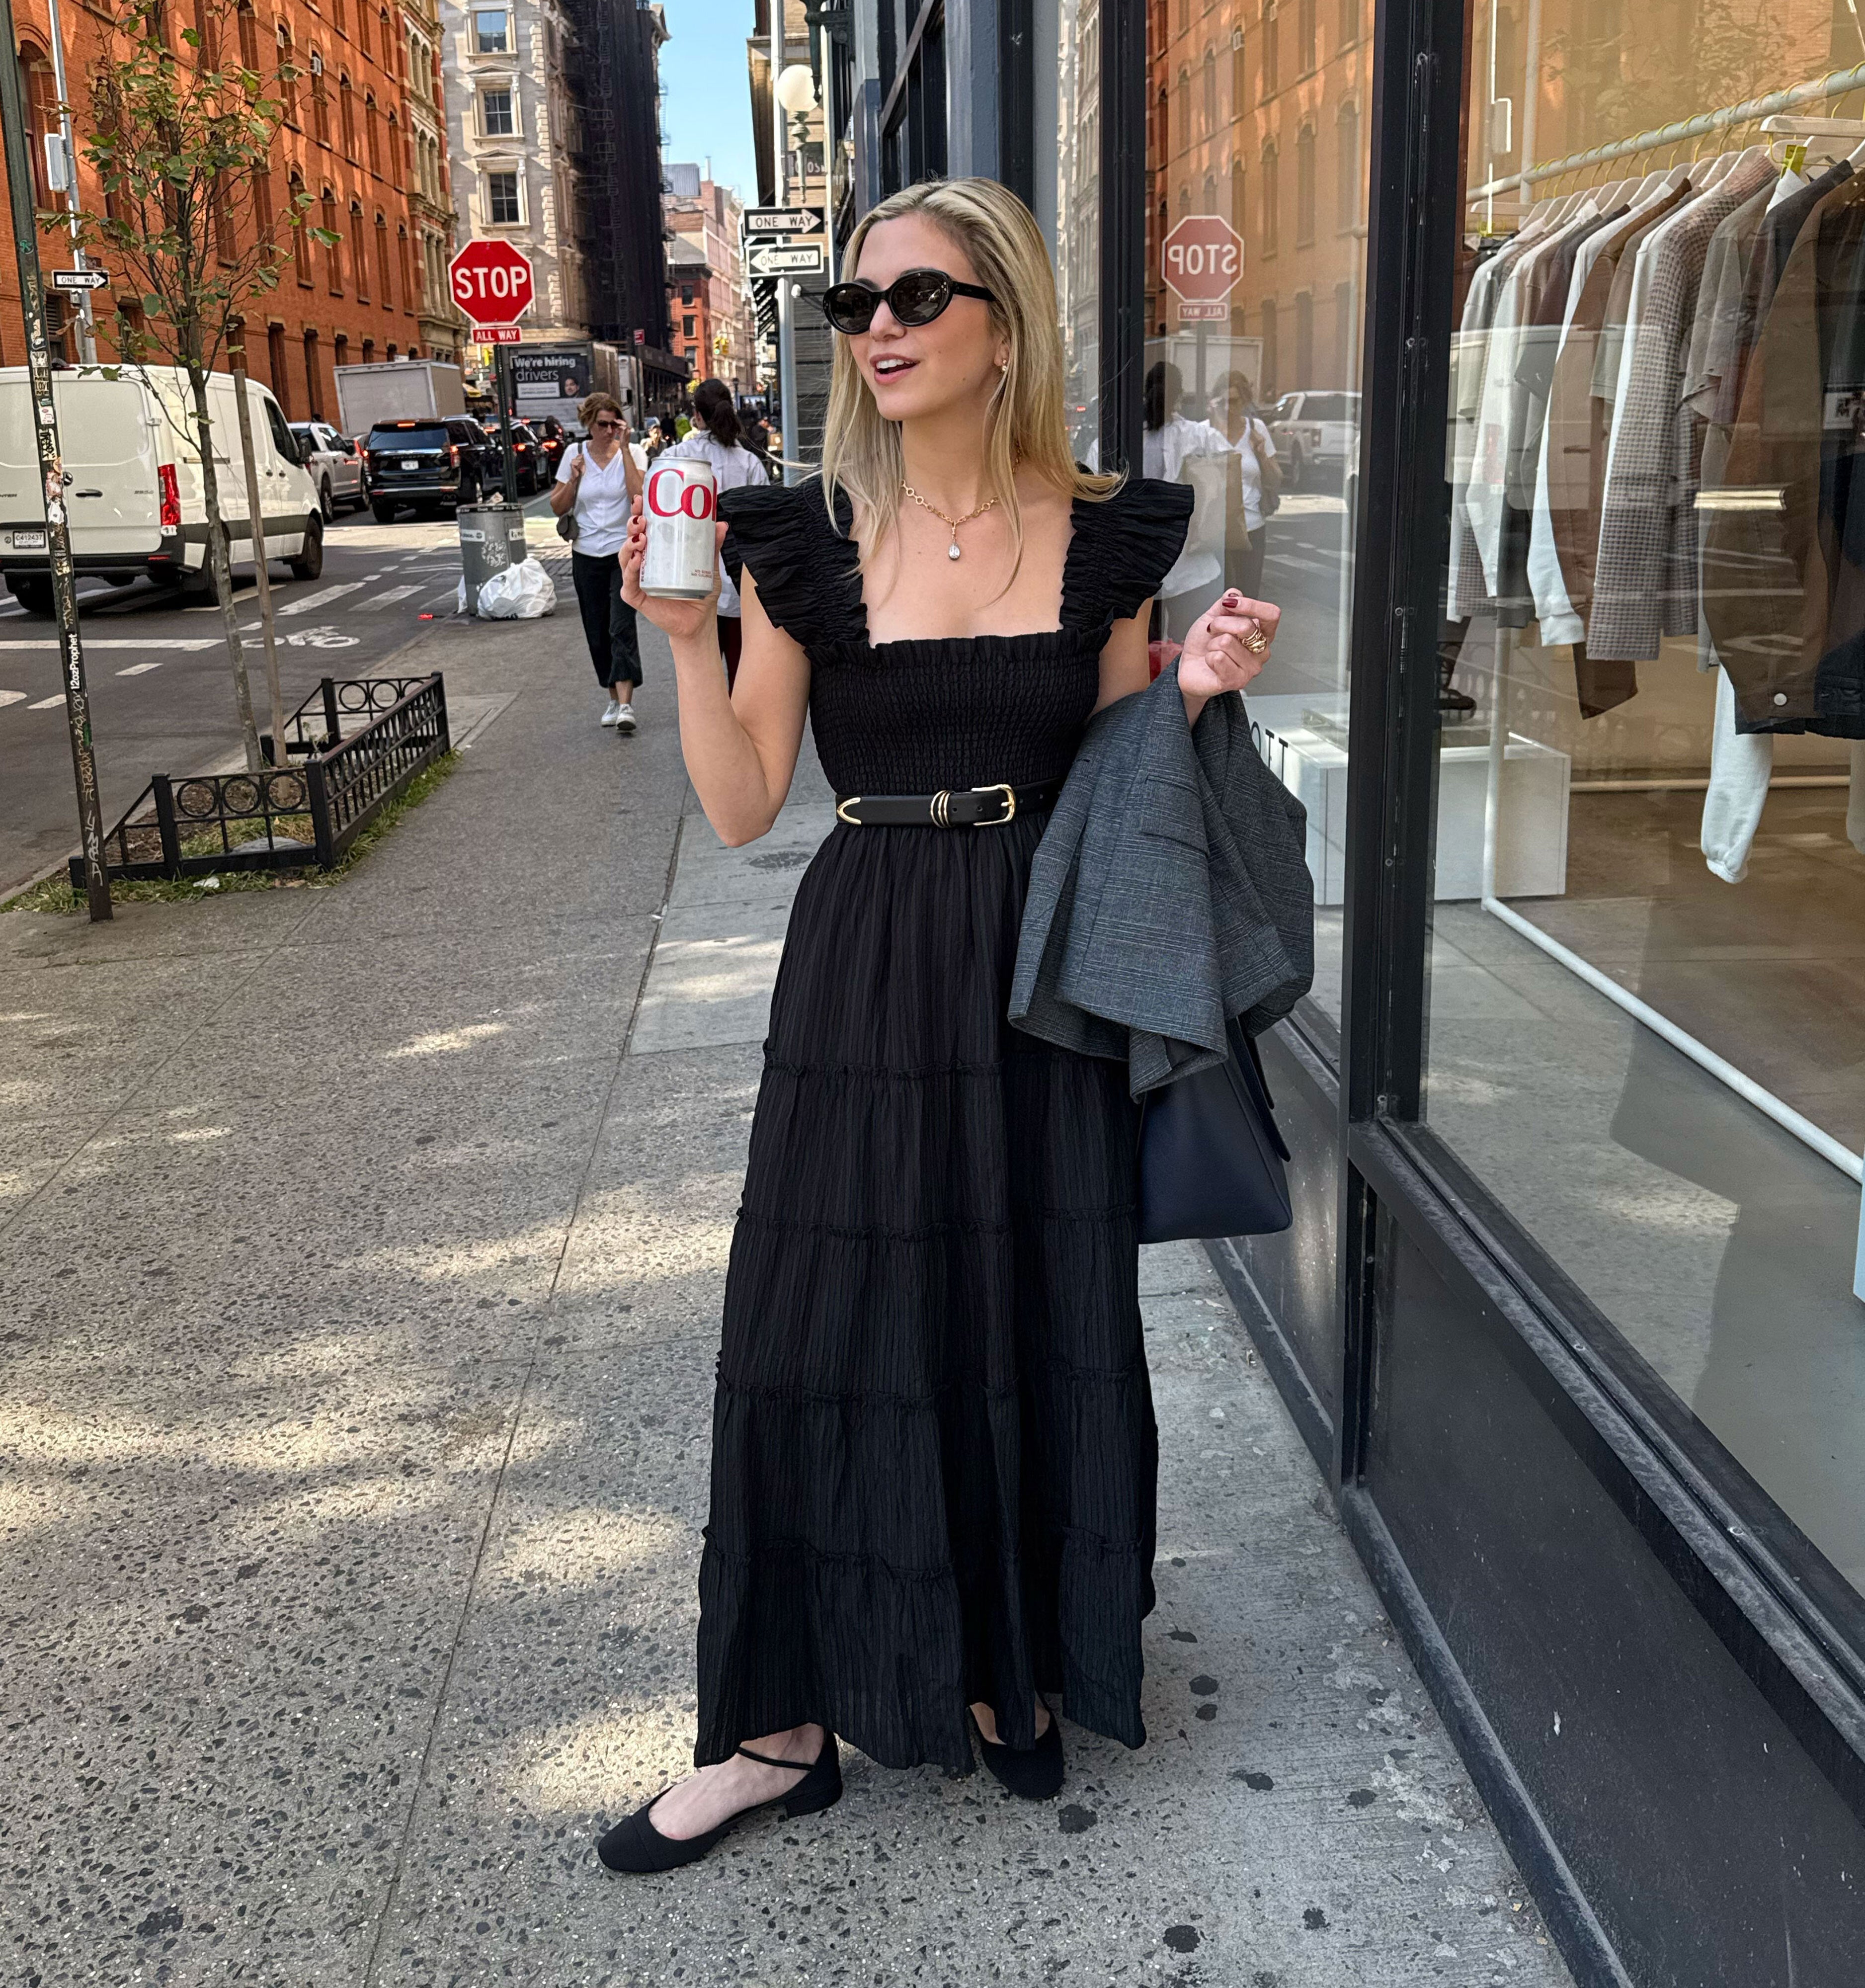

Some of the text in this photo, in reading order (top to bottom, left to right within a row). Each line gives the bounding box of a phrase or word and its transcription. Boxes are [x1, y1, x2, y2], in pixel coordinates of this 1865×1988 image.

[755, 215, 812, 227] ONE WAY
[761, 253, 812, 265] ONE WAY
[455, 266, 528, 299] STOP
[476, 330, 517, 341] ALL WAY
[514, 356, 576, 368] We're hiring
[515, 368, 559, 382] drivers
[69, 633, 80, 689] 12ozProphet
